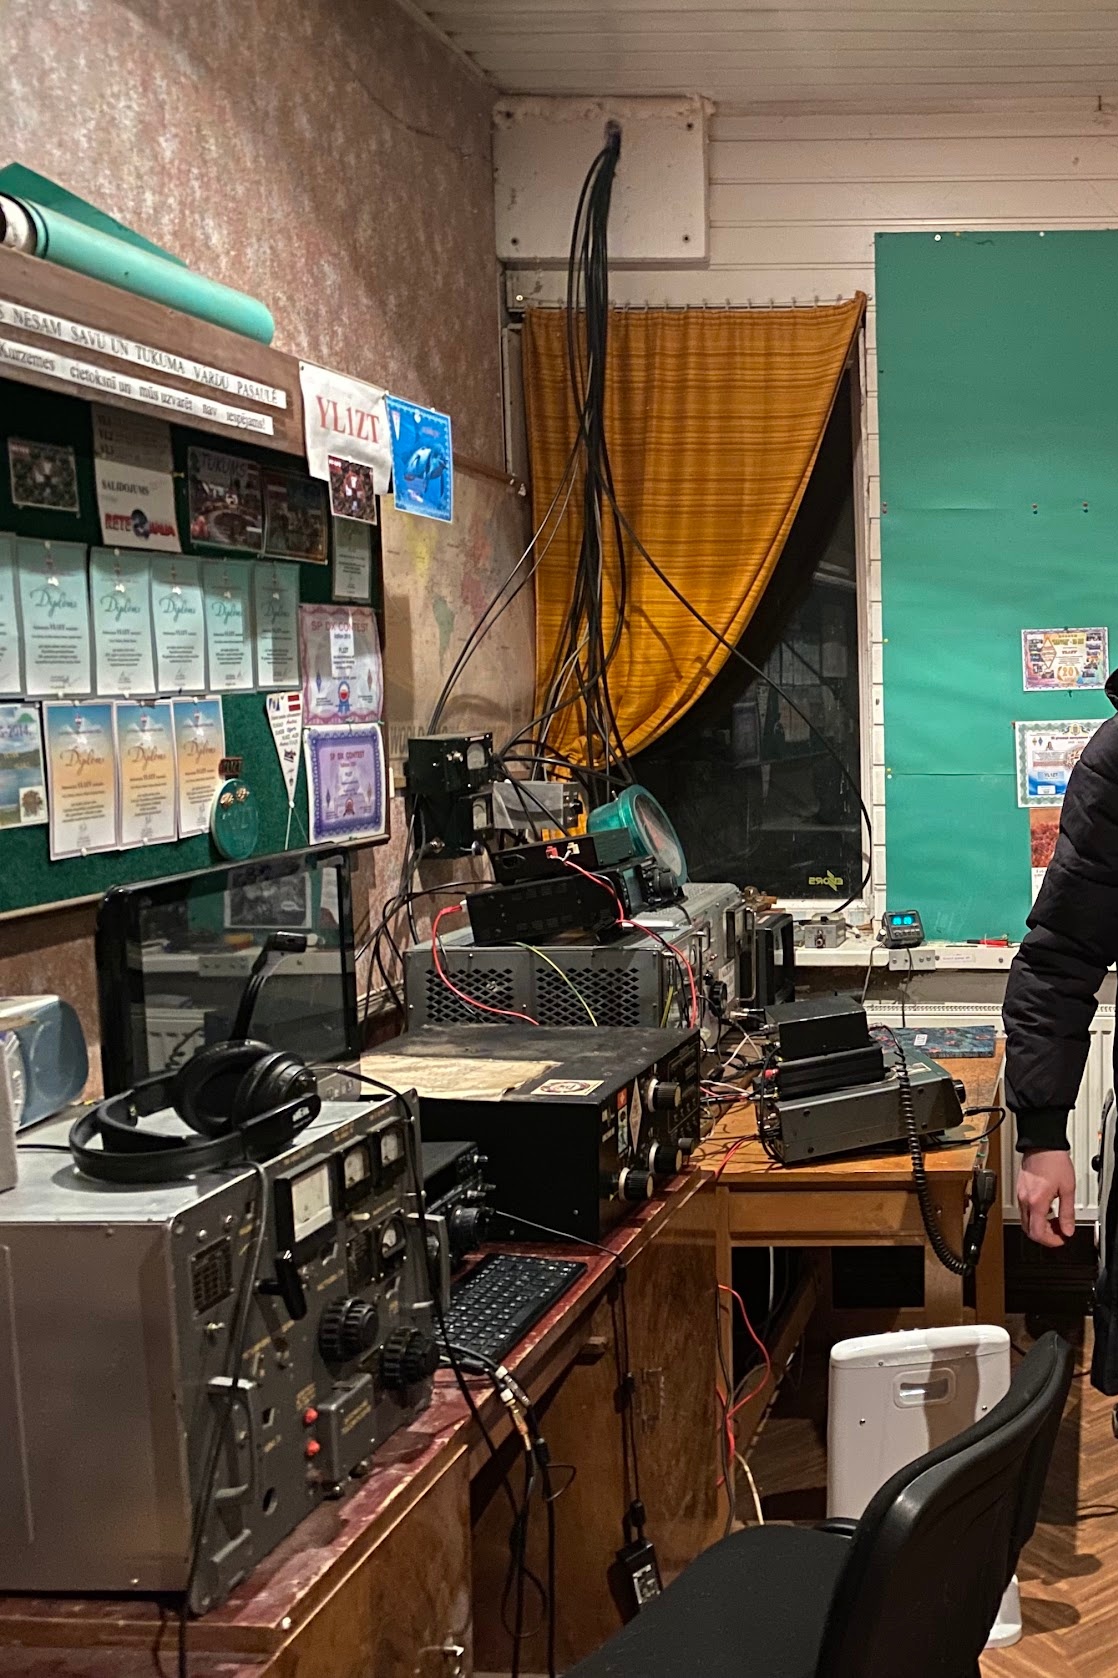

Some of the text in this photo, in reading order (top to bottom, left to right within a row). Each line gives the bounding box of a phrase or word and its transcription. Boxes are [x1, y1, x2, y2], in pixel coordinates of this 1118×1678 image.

[13, 307, 62, 337] NESAM
[111, 337, 129, 356] UN
[134, 344, 186, 375] TUKUMA
[202, 403, 218, 417] nav
[316, 394, 380, 445] YL1ZT
